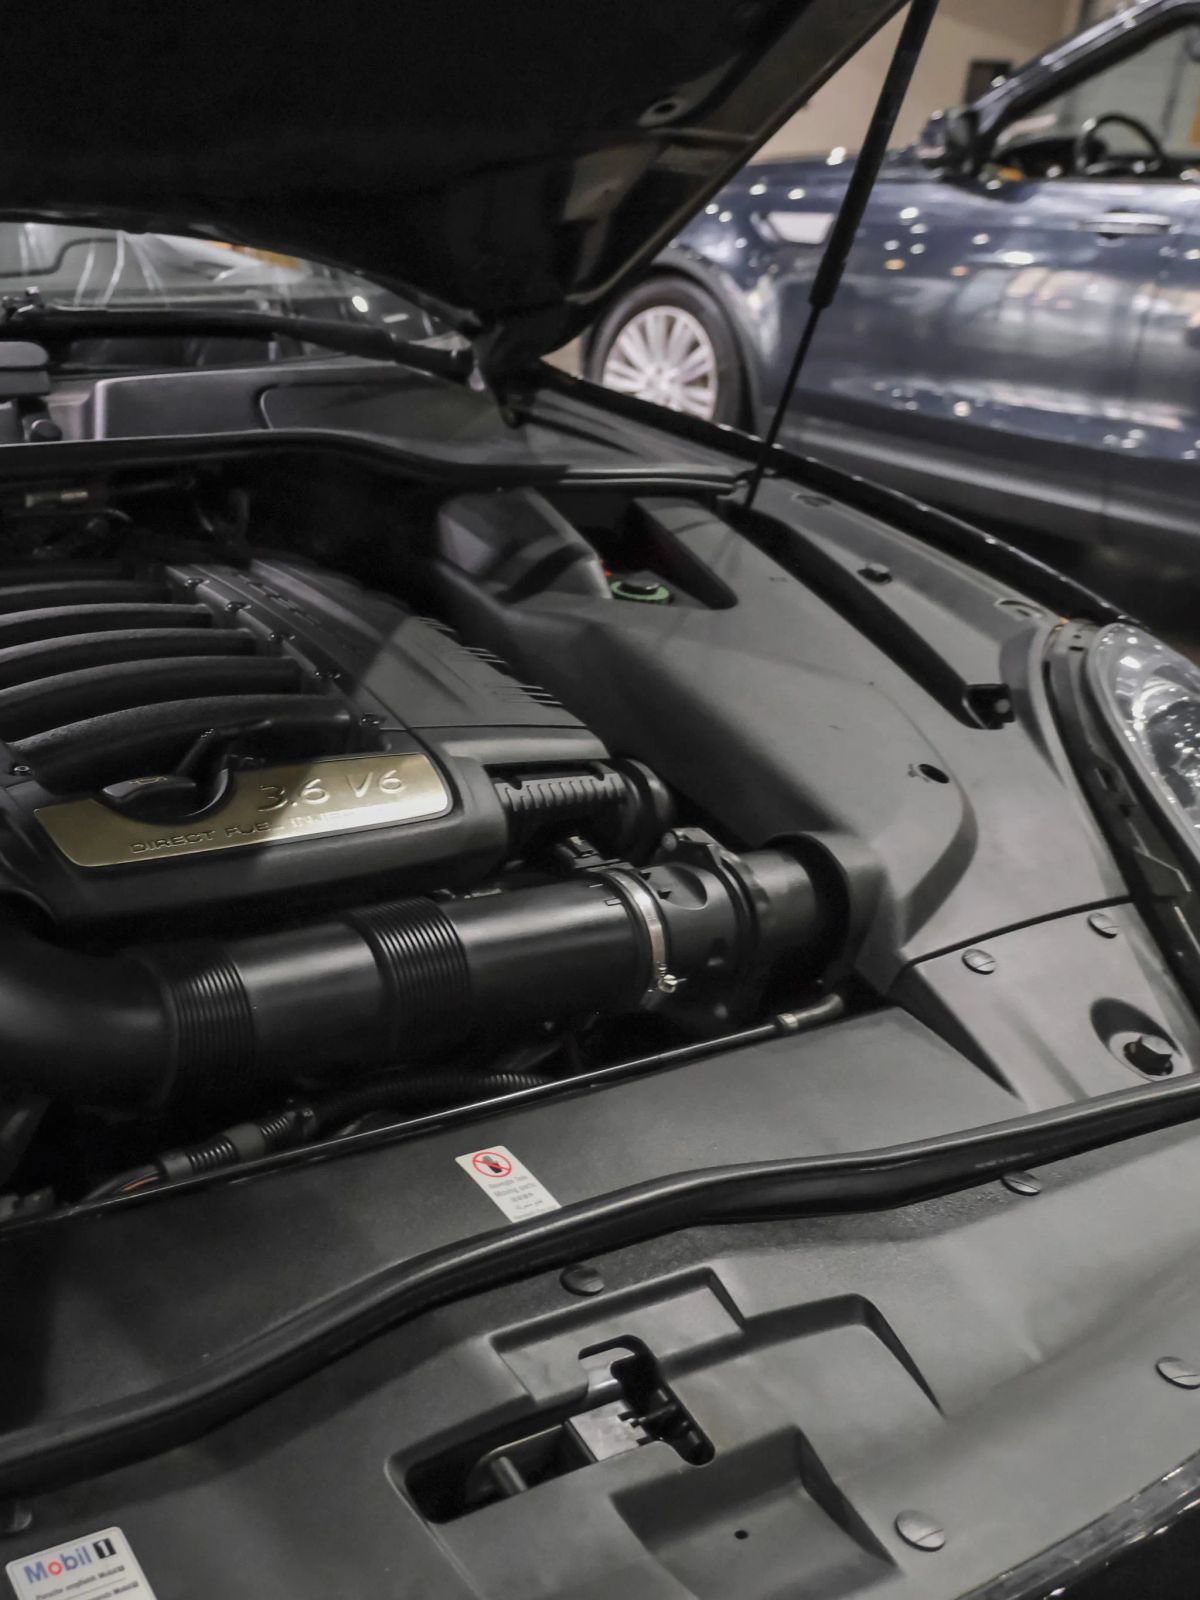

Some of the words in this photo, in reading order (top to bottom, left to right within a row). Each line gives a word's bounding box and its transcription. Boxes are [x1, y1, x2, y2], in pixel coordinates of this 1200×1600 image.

[257, 778, 331, 812] 3.6
[346, 769, 407, 799] V6
[129, 830, 216, 854] DIRECT
[23, 1546, 92, 1584] Mobil
